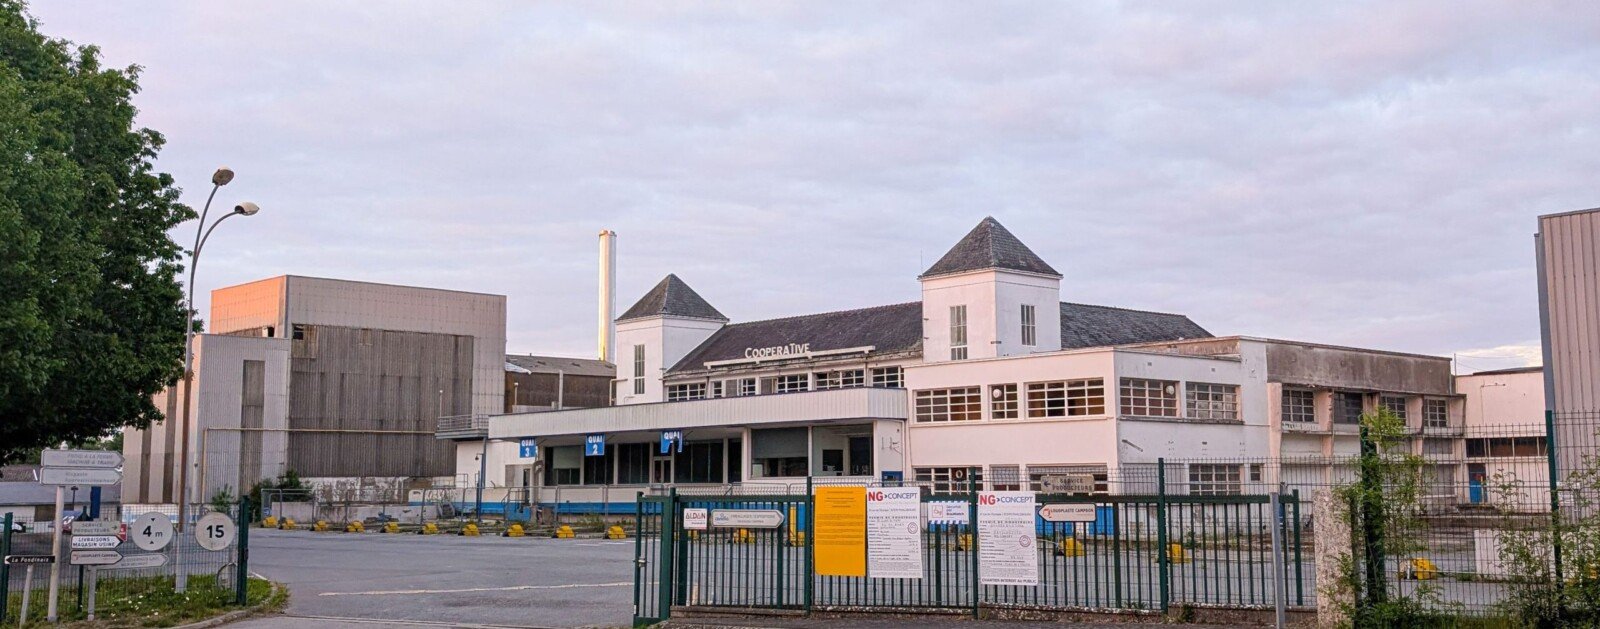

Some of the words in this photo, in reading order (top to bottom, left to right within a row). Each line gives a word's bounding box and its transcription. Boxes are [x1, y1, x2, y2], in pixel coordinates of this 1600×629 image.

[744, 343, 810, 359] COOPERATIVE
[587, 435, 603, 444] QUAI
[663, 431, 680, 439] QUAI
[525, 448, 530, 457] 3
[592, 444, 598, 455] 2
[868, 492, 884, 501] NG
[980, 494, 996, 505] NG
[142, 525, 152, 537] 4
[206, 525, 224, 538] 15
